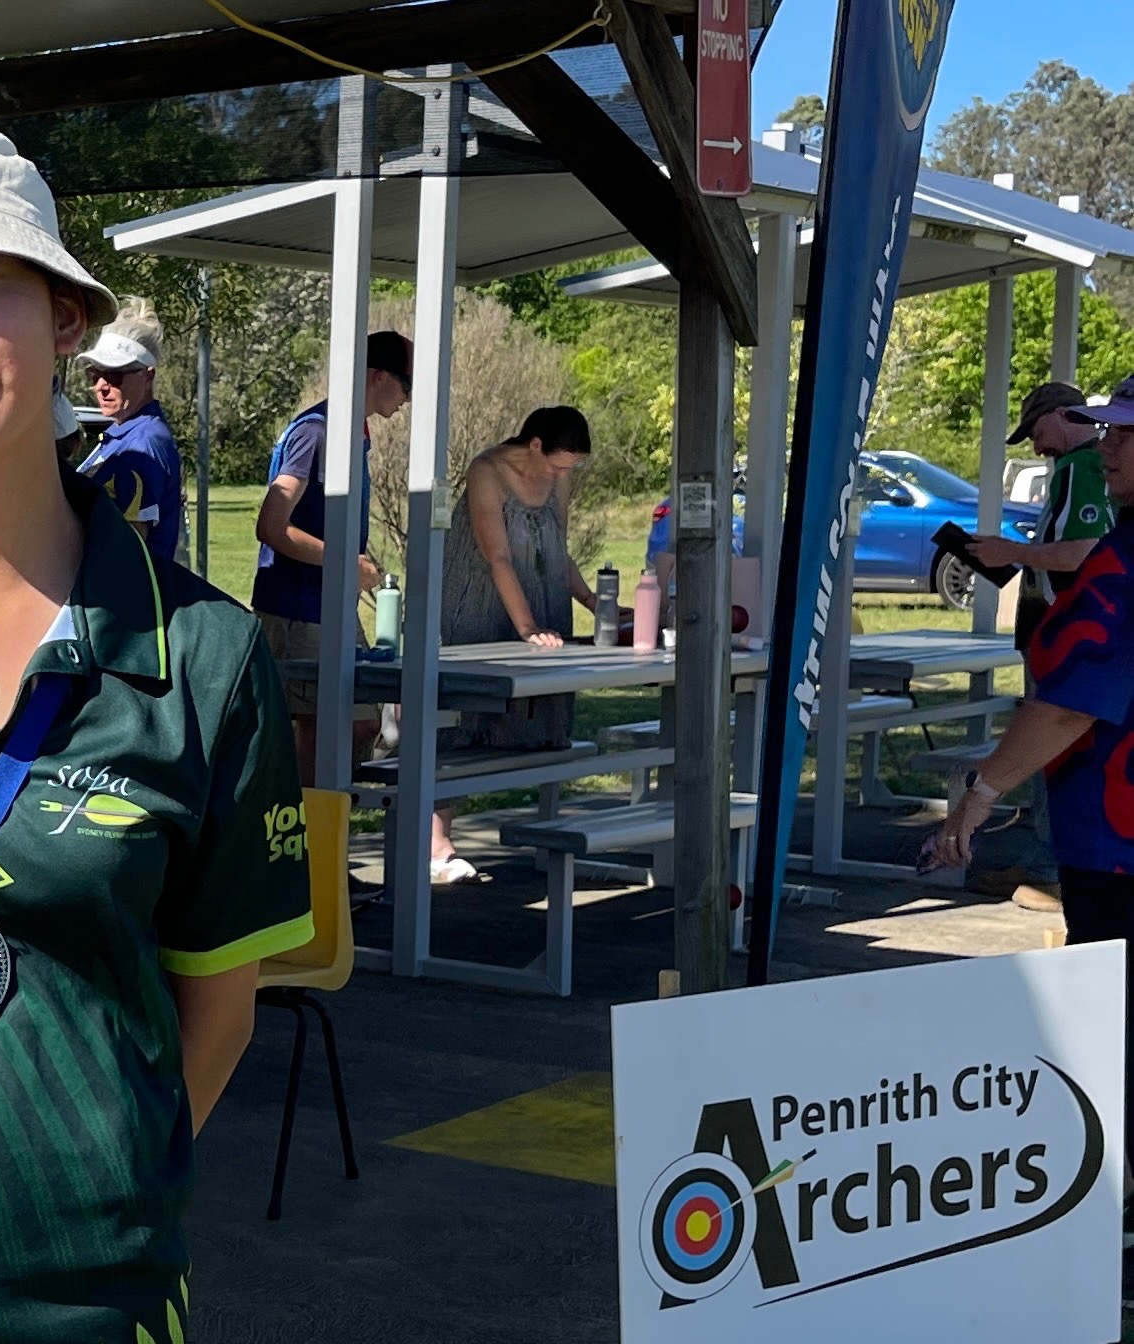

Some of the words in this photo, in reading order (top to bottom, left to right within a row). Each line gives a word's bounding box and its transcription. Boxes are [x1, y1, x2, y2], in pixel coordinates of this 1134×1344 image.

[701, 29, 744, 62] STOPPING
[772, 1072, 938, 1141] Penrith
[952, 1063, 1040, 1118] City
[658, 1097, 1049, 1311] Archers
